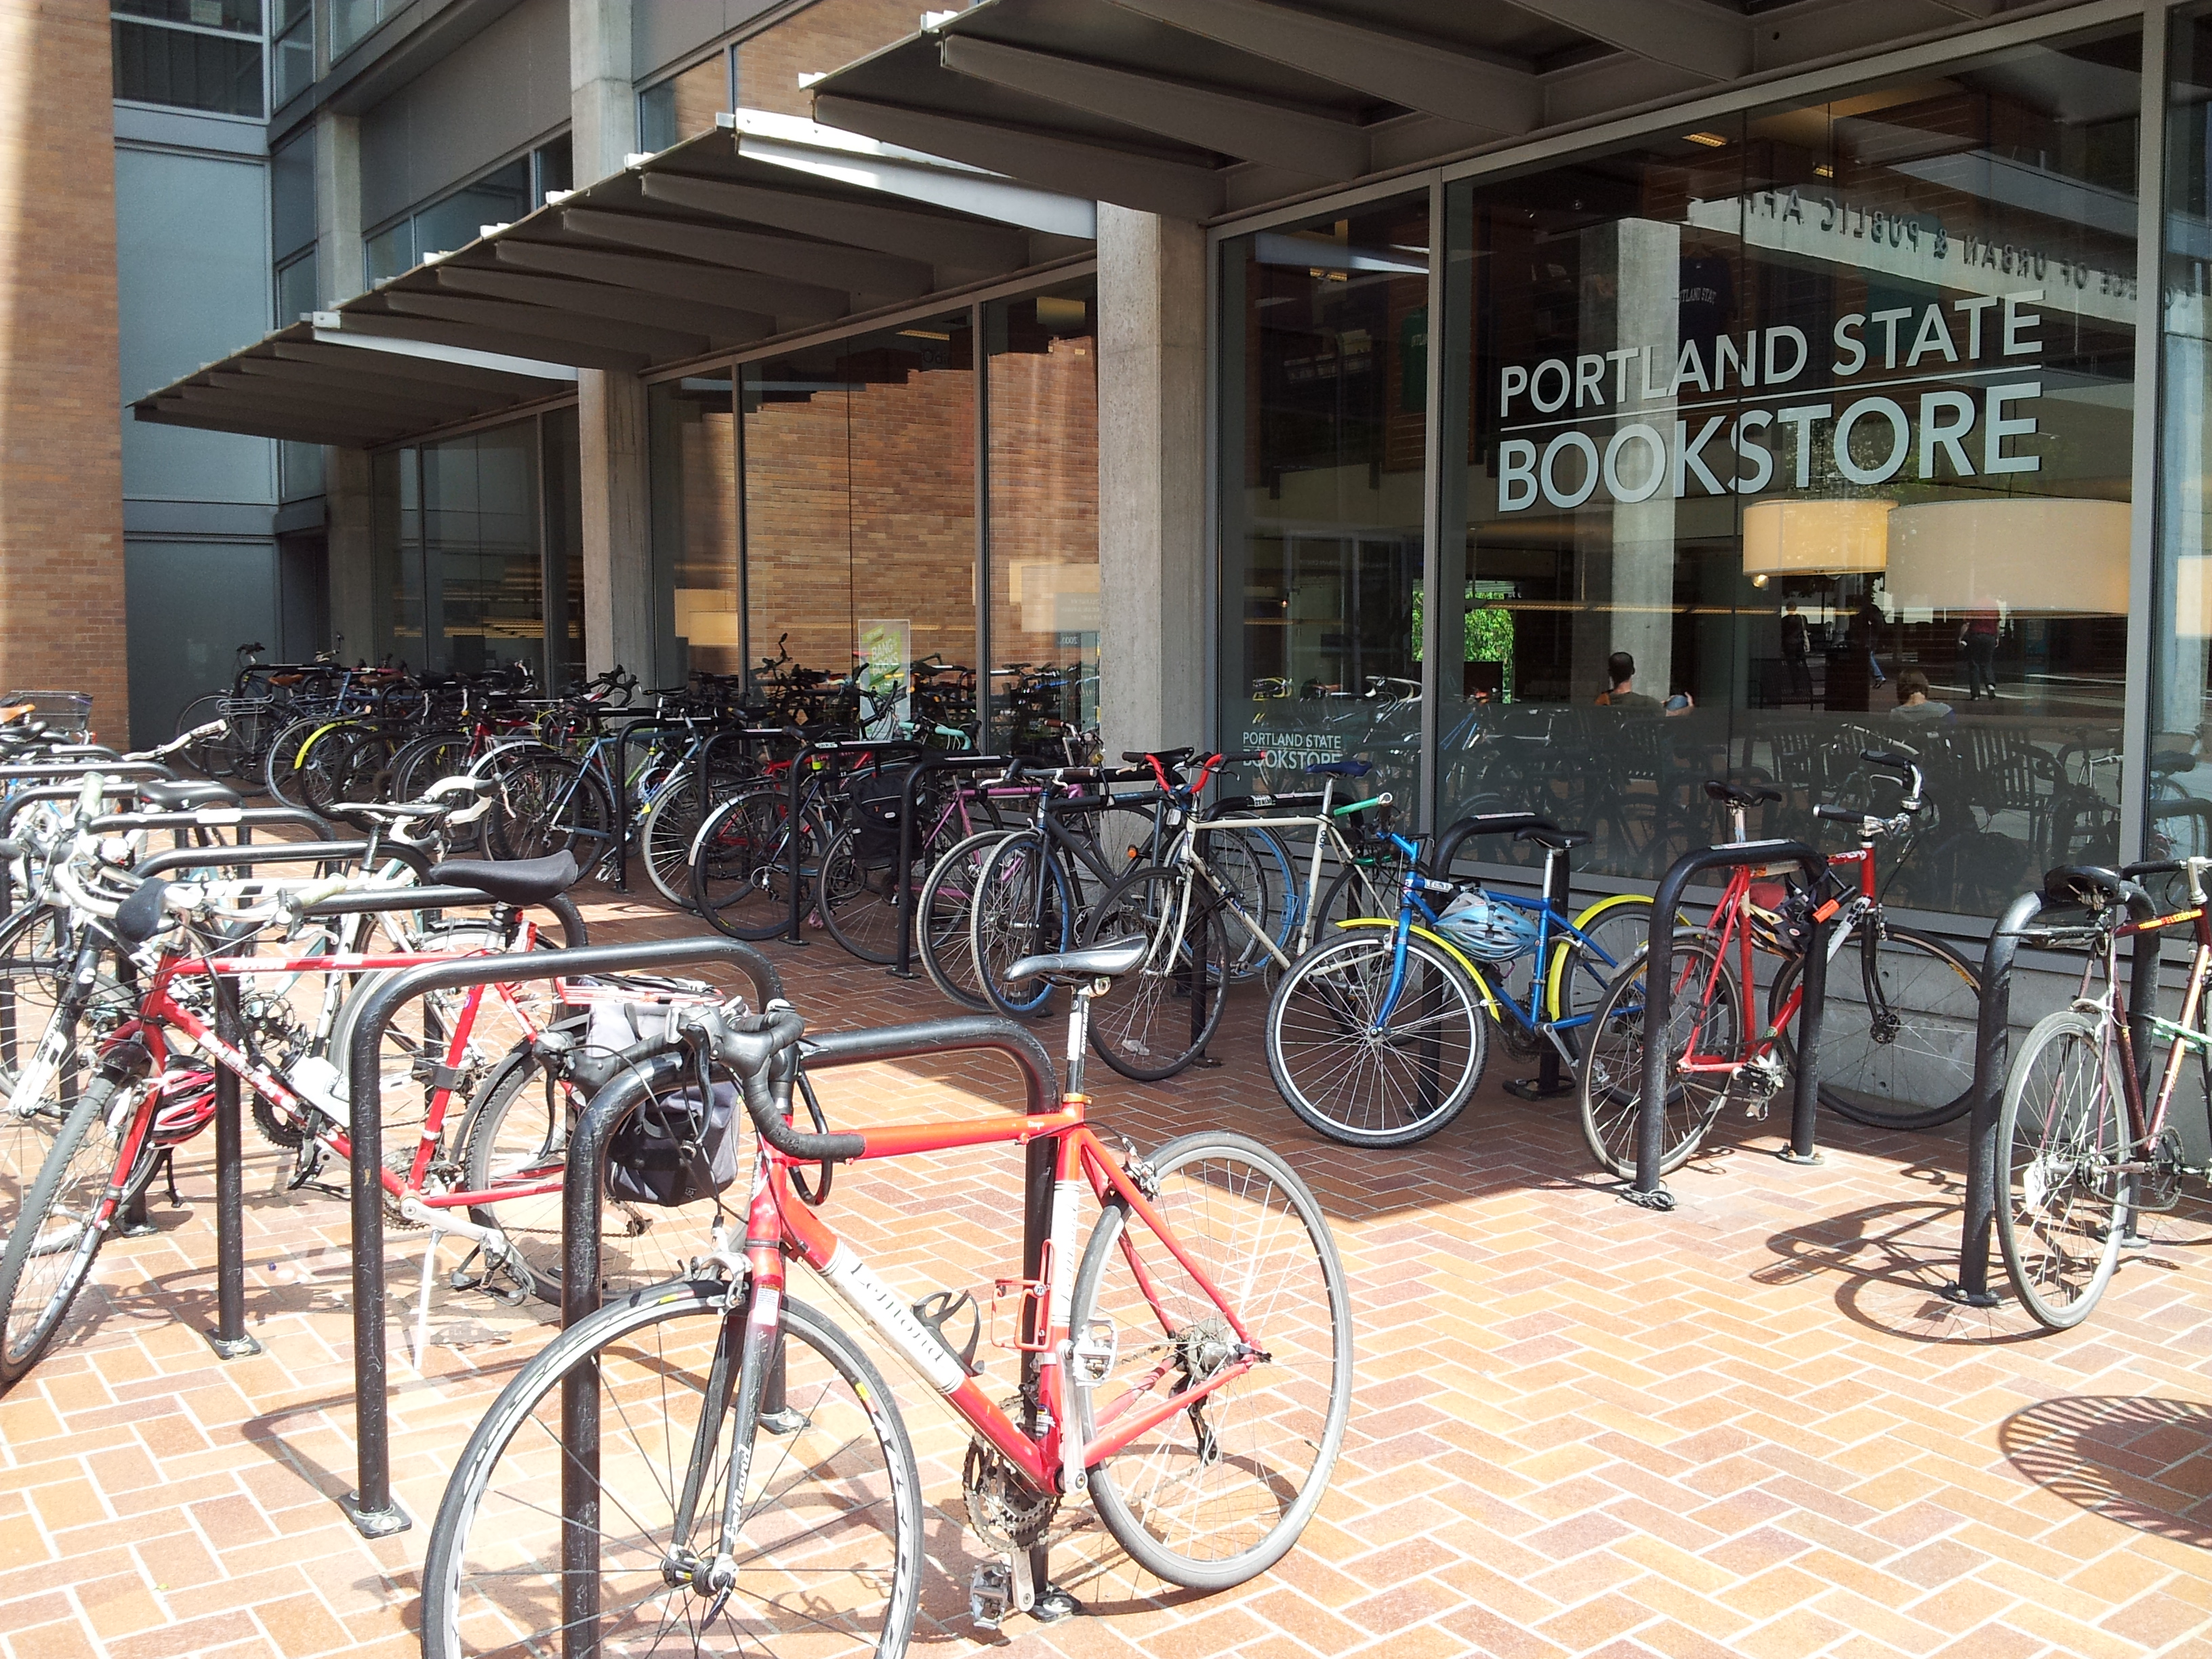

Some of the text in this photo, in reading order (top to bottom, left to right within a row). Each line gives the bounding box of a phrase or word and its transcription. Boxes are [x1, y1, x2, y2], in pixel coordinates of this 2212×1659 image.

[1500, 289, 2045, 418] PORTLAND STATE
[1498, 381, 2042, 513] BOOKSTORE
[1243, 731, 1341, 749] PORTLAND STATE
[1081, 1000, 1089, 1055] BONTRAGER
